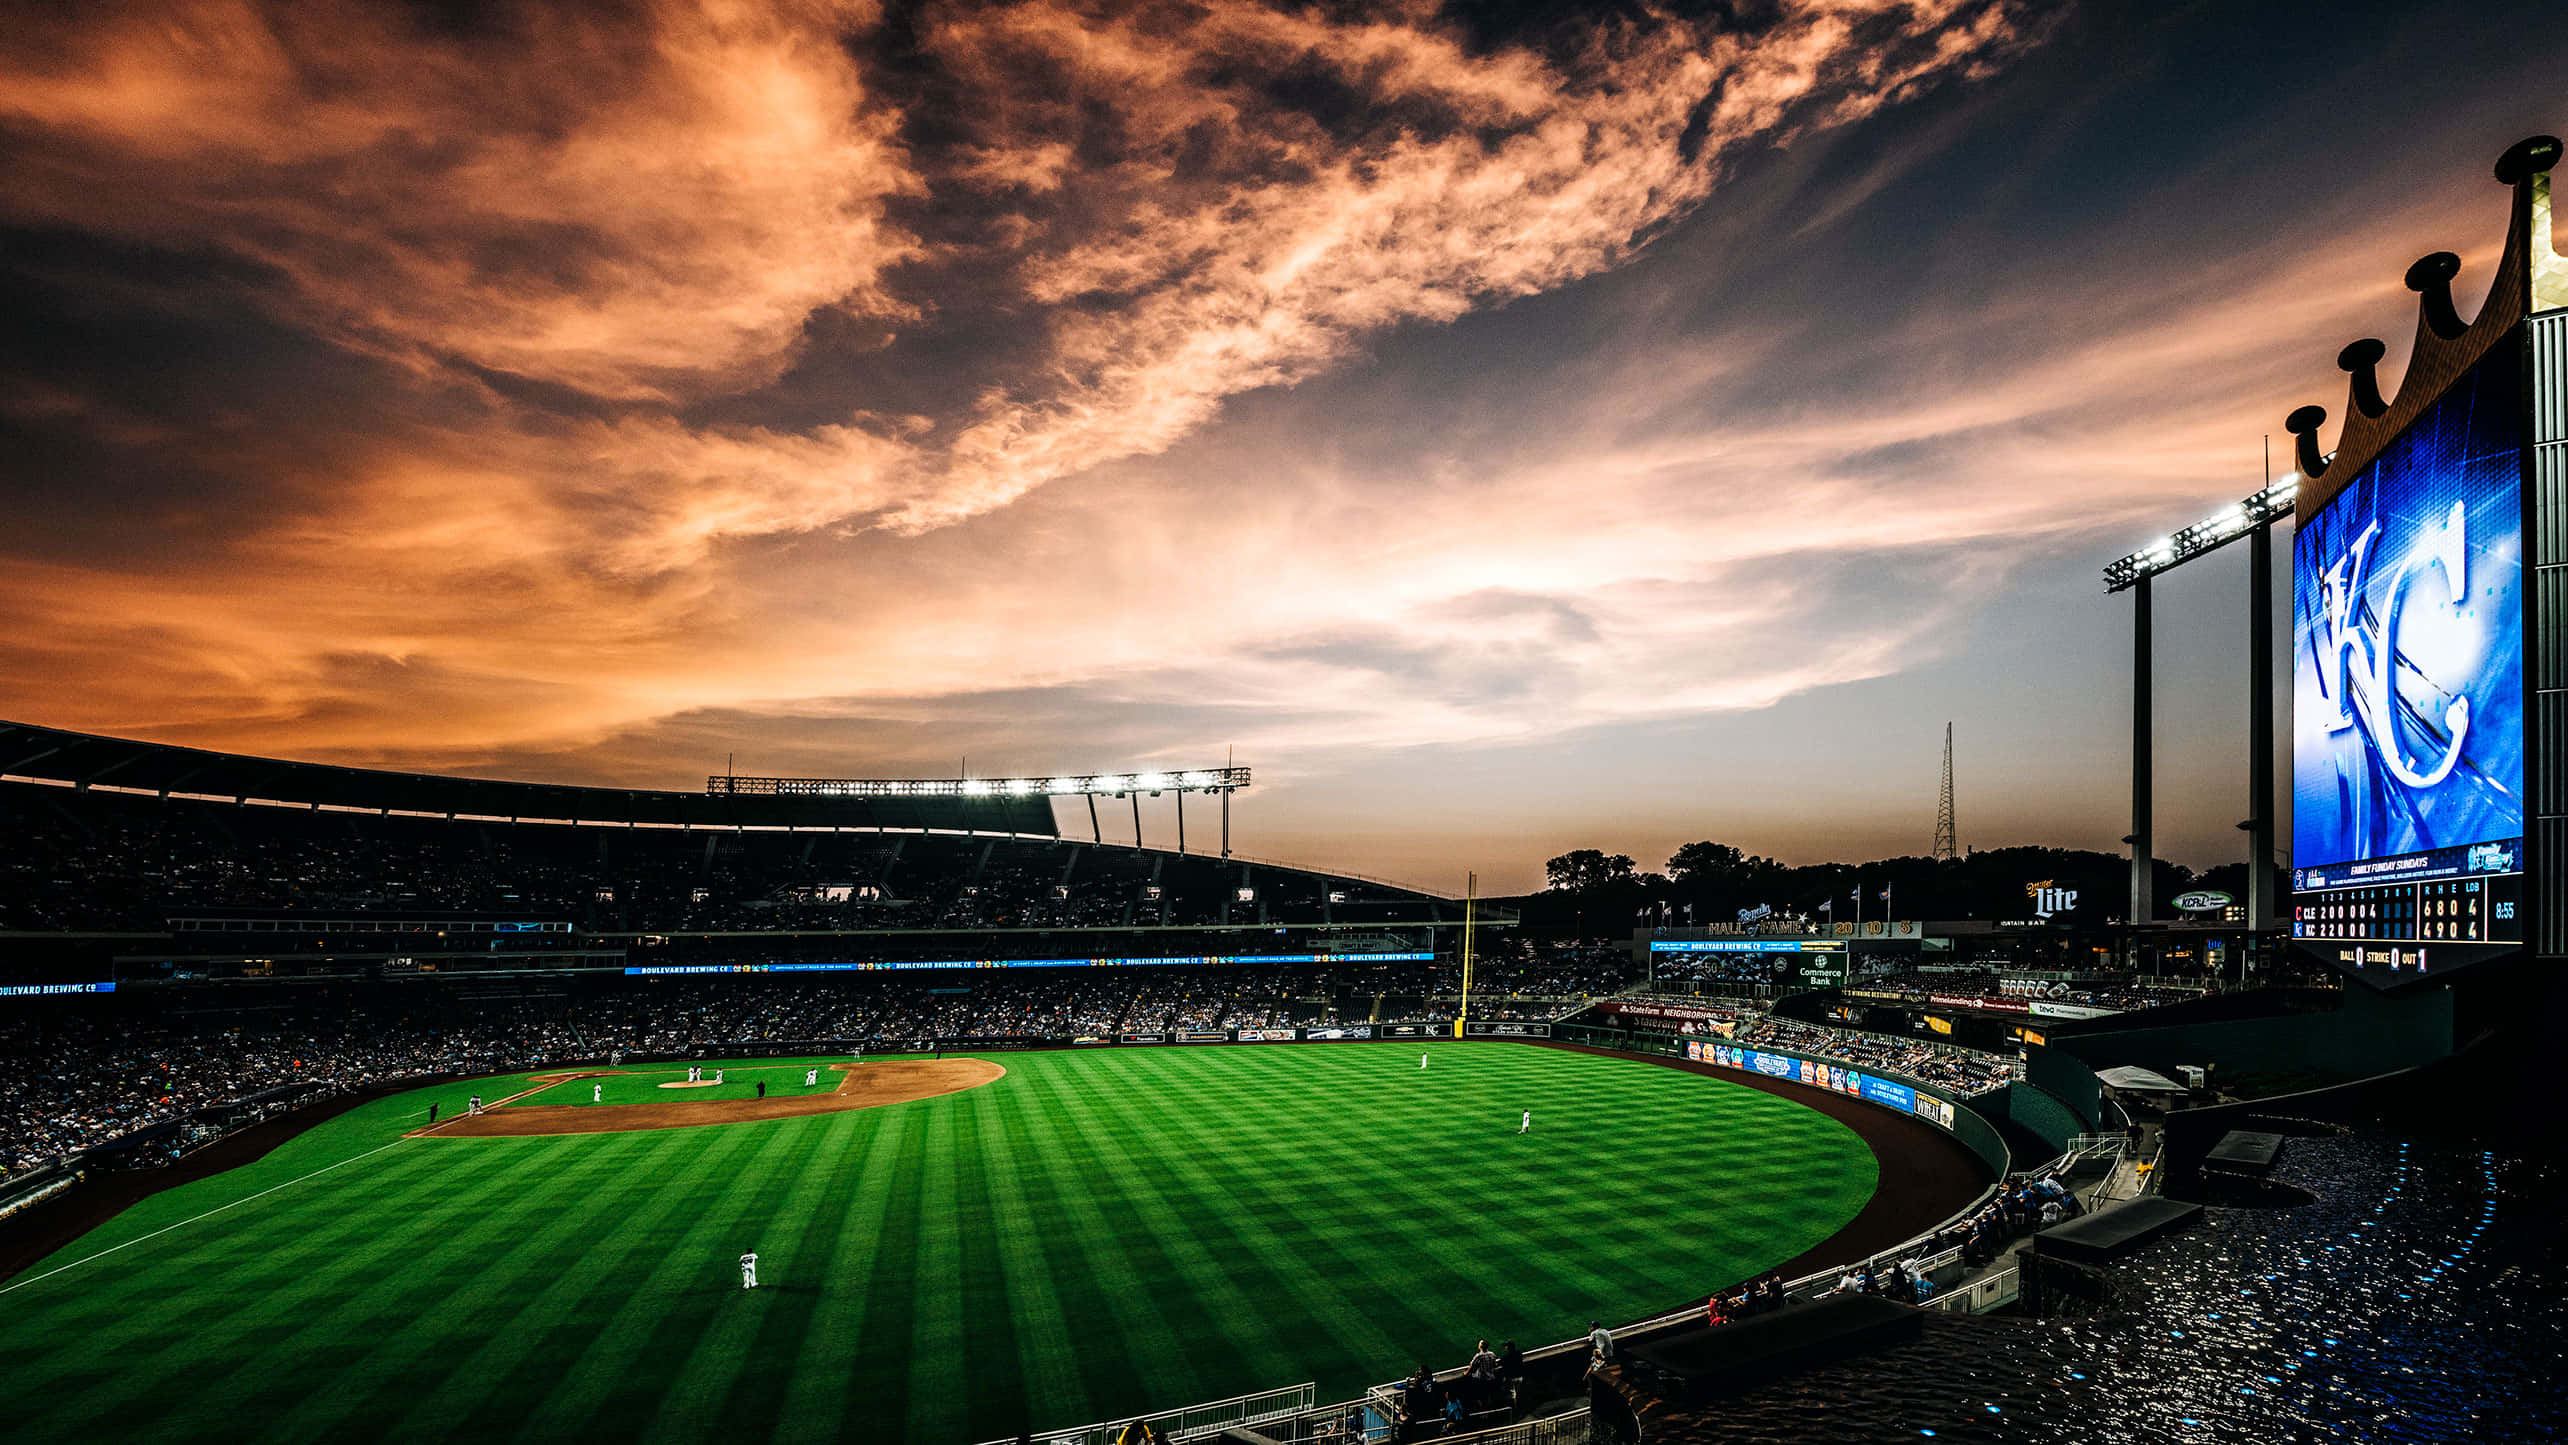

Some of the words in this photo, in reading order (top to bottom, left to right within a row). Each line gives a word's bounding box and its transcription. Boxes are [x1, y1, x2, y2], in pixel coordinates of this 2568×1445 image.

[2351, 864, 2372, 876] FAMILY
[2371, 860, 2395, 873] FUNDAY
[2395, 857, 2428, 870] SUNDAYS
[2035, 888, 2078, 918] Lite
[2303, 907, 2316, 920] CLE
[2320, 906, 2326, 920] 2
[2329, 905, 2335, 919] 0
[2338, 905, 2344, 919] 0
[2350, 904, 2356, 919] 0
[2360, 904, 2366, 919] 0
[2369, 903, 2376, 919] 4
[2424, 901, 2431, 916] 6
[2437, 900, 2444, 916] 8
[2450, 900, 2457, 916] 0
[2468, 899, 2476, 916] 4
[2496, 902, 2514, 919] 8:55
[1737, 903, 1772, 922] Royals
[1709, 921, 1745, 935] HALL
[1760, 920, 1804, 935] FAME
[1835, 922, 1853, 935] 20
[1866, 921, 1881, 934] 10
[1899, 920, 1911, 934] 5
[2305, 923, 2316, 937] KC
[2320, 923, 2326, 937] 2
[2329, 923, 2335, 937] 2
[2338, 923, 2344, 937] 0
[2349, 923, 2356, 937] 0
[2359, 922, 2366, 937] 0
[2423, 922, 2431, 938] 4
[2437, 922, 2444, 938] 9
[2450, 922, 2457, 938] 0
[2468, 922, 2476, 938] 4
[2340, 950, 2355, 961] BALL
[2356, 946, 2363, 966] 0
[2366, 952, 2390, 963] STRIKE
[2391, 948, 2400, 968] 0
[2402, 953, 2416, 965] OUT
[2418, 948, 2426, 970] 1
[1799, 967, 1842, 978] Commerce
[1810, 976, 1831, 986] Bank
[43, 984, 84, 994] BREWING
[1709, 1023, 1734, 1034] SONIC
[1916, 1098, 1939, 1121] WHEAT
